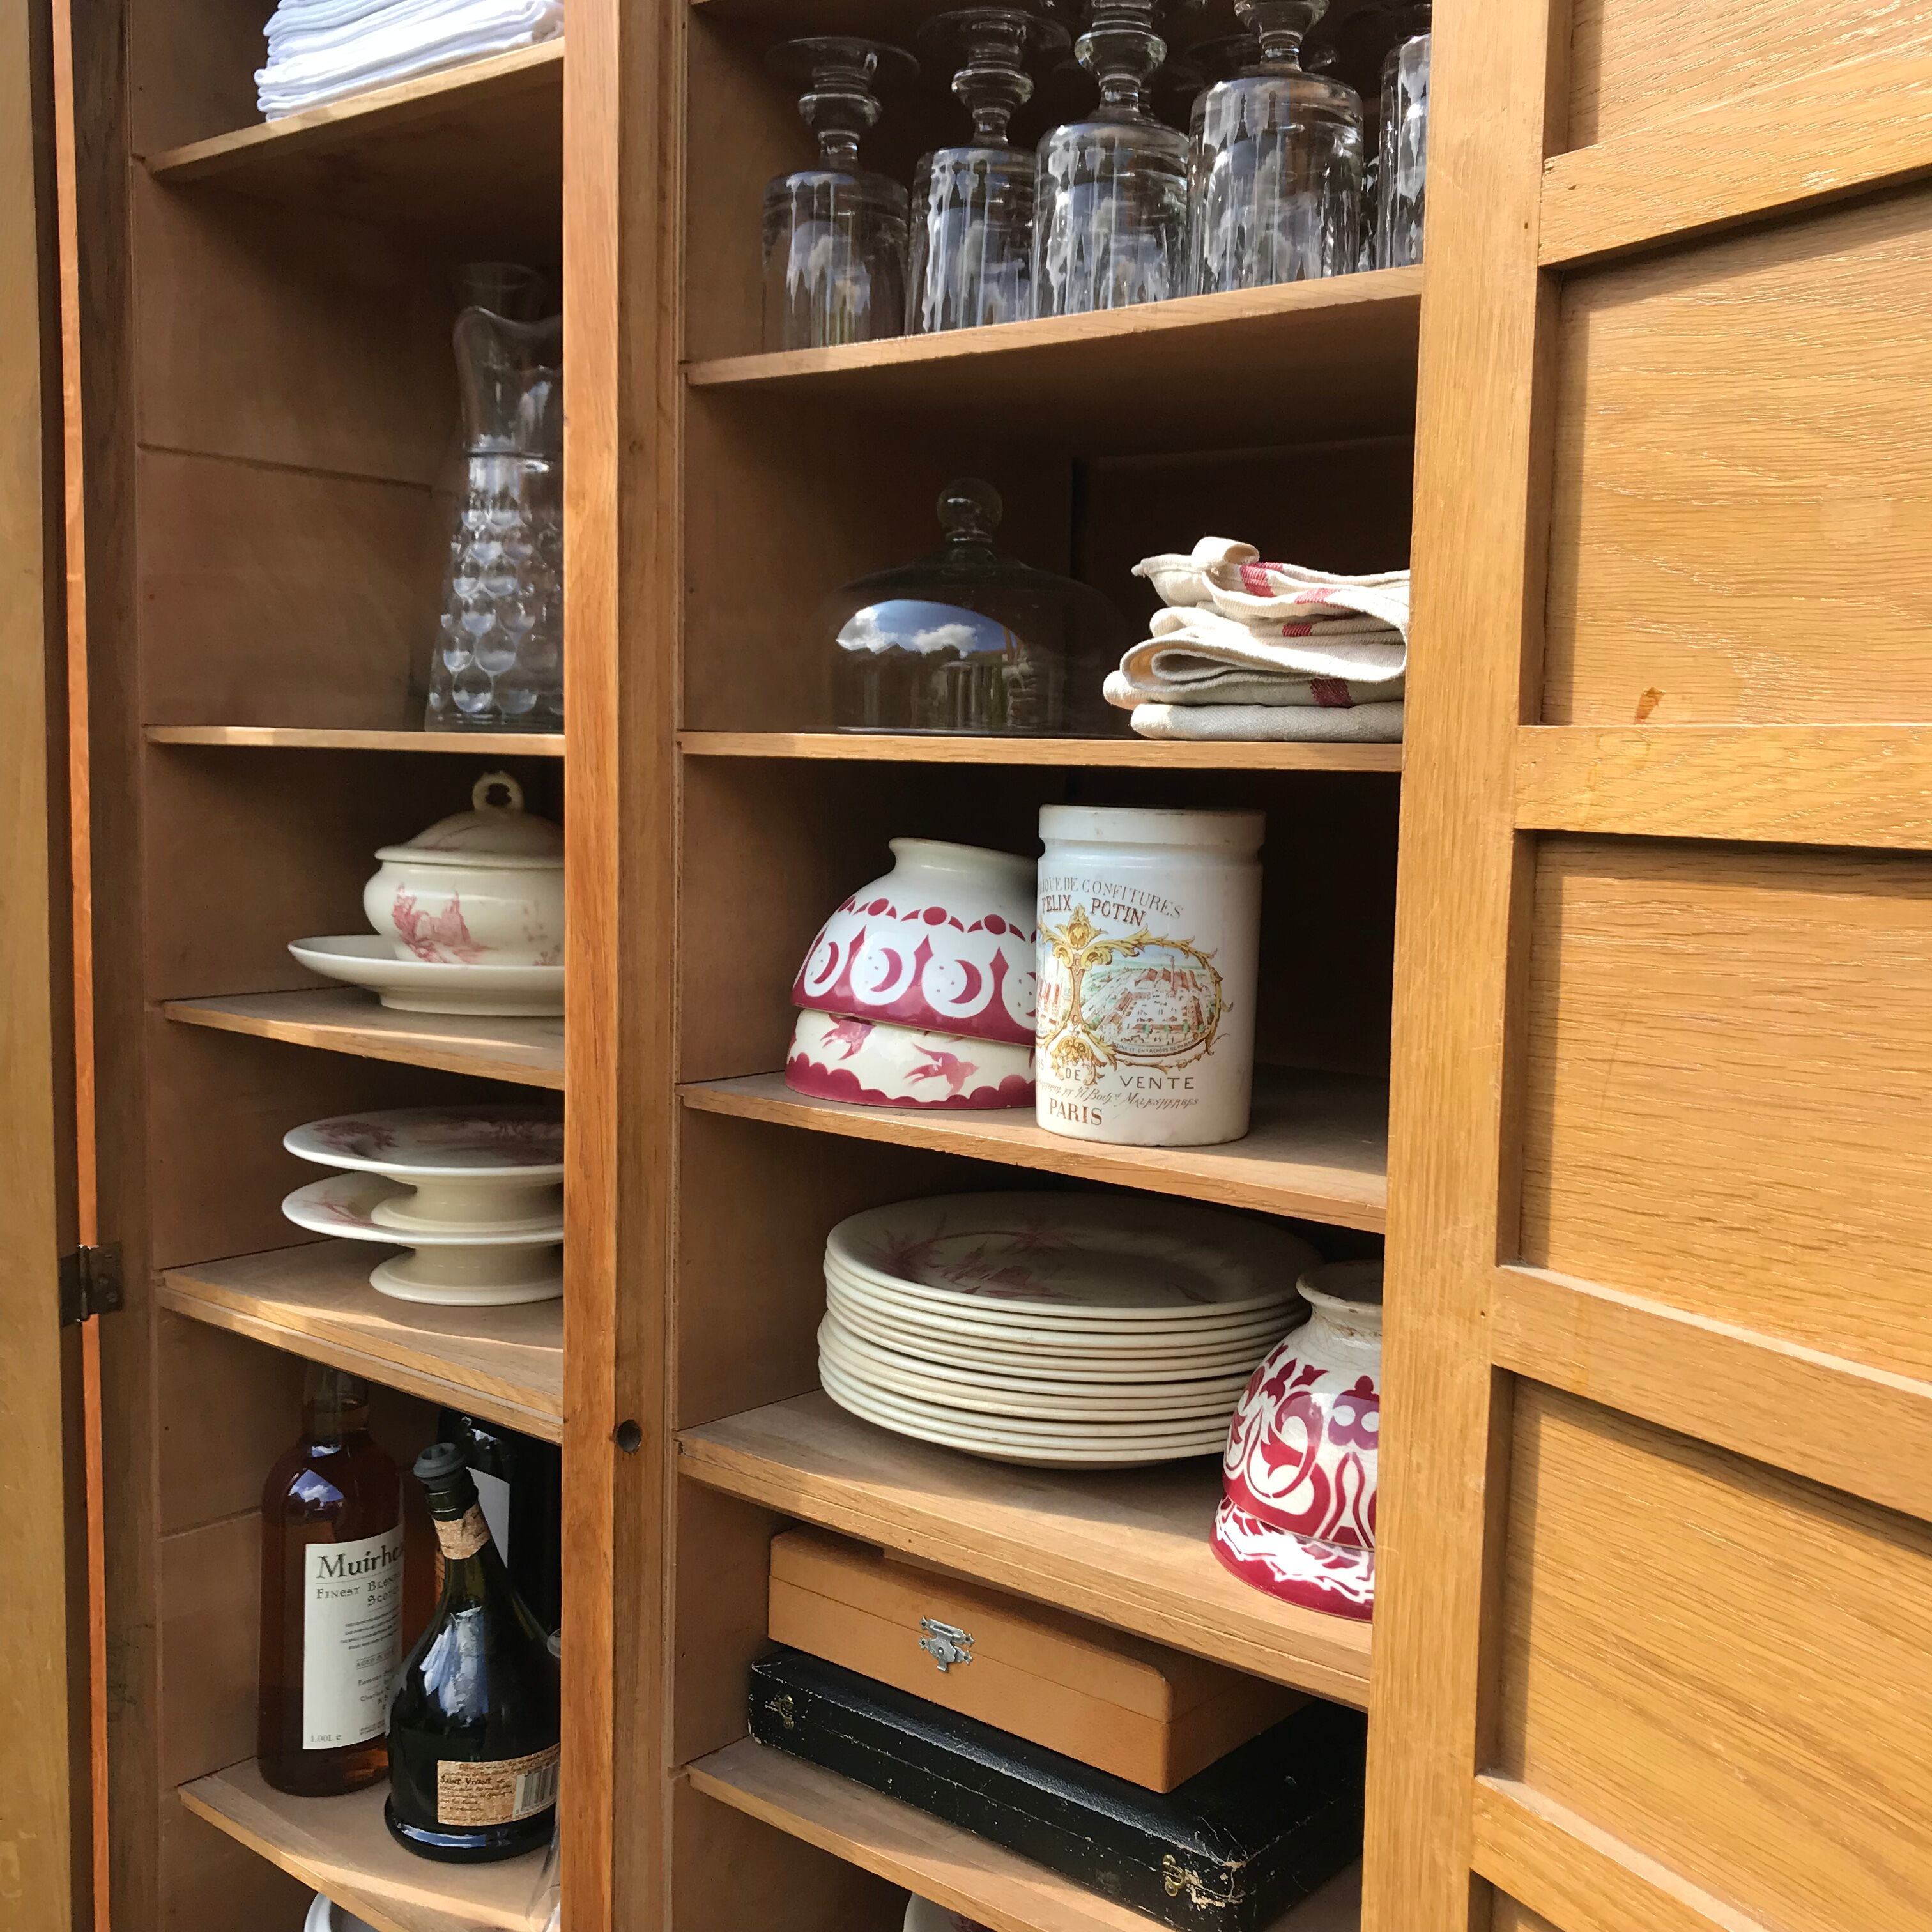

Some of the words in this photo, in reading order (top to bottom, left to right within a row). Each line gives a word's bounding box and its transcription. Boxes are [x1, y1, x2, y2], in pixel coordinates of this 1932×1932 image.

[1041, 894, 1072, 914] FELIX
[1090, 897, 1147, 927] POTIN
[1064, 877, 1078, 892] DE
[1082, 879, 1184, 919] CONFITURES
[1066, 1068, 1081, 1082] DE
[1119, 1075, 1195, 1090] VENTE
[1049, 1097, 1103, 1126] PARIS
